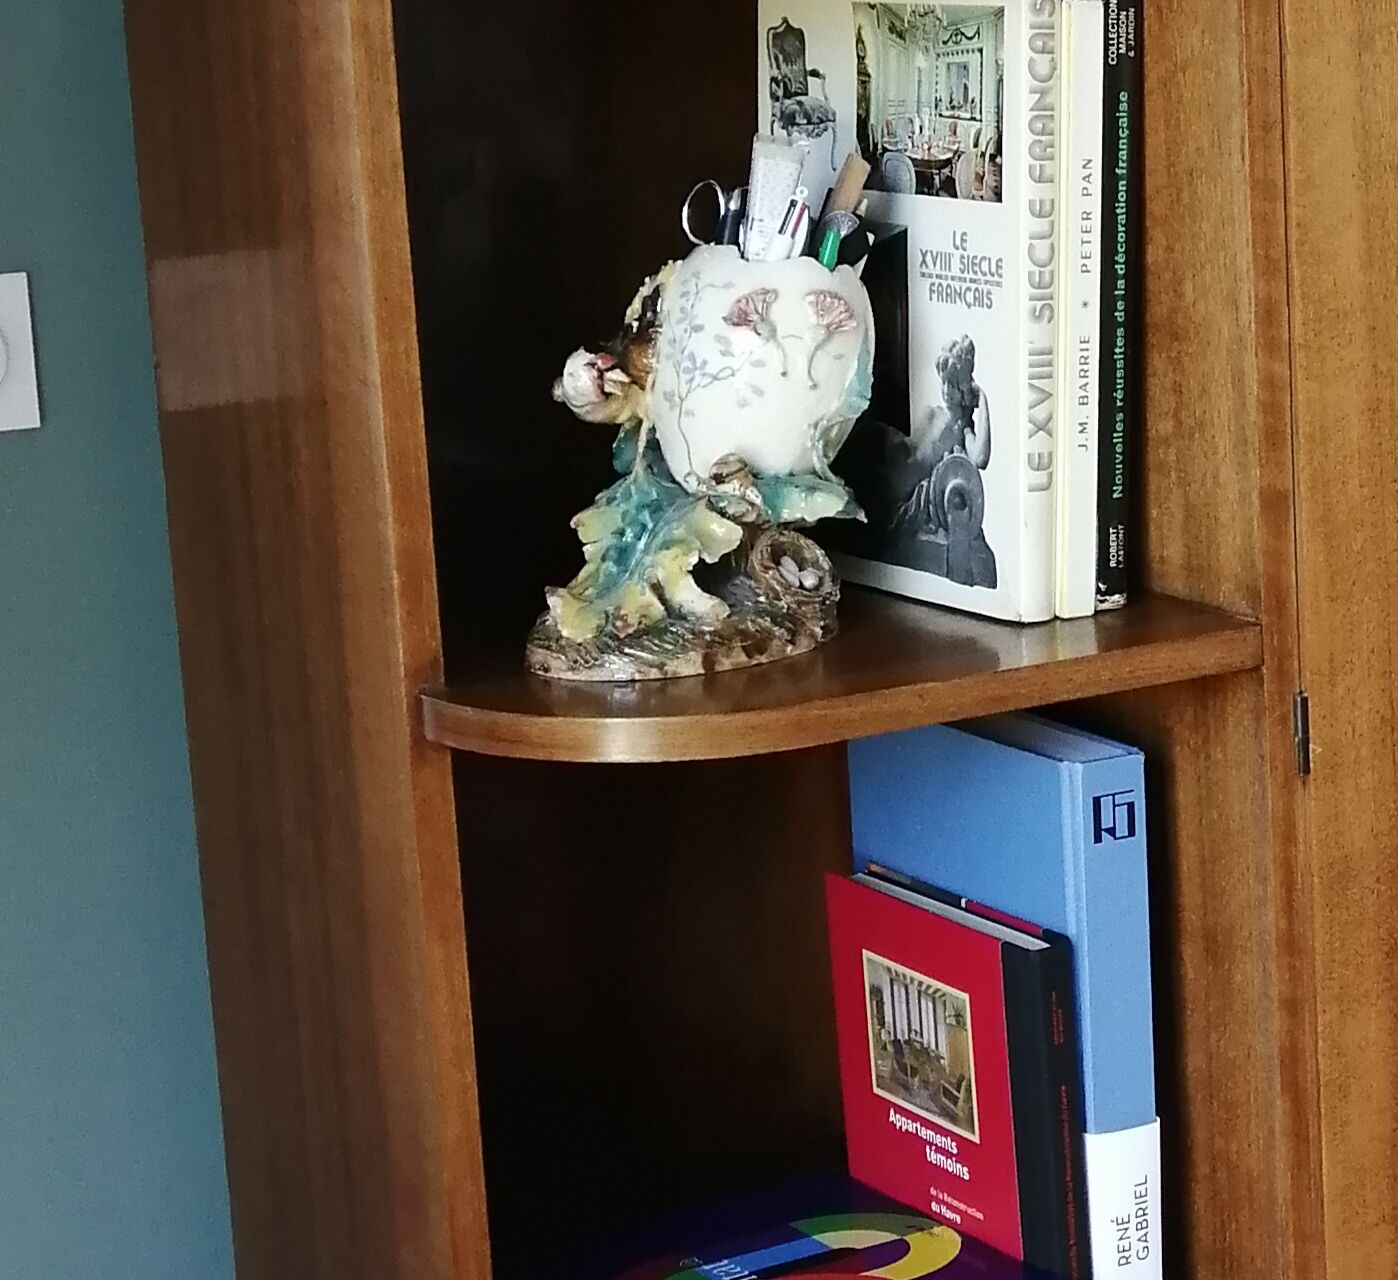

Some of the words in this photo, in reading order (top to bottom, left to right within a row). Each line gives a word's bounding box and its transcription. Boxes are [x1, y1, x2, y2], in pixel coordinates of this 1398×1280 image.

[1108, 0, 1118, 65] COLLECTION
[1119, 11, 1127, 54] MAISON
[1128, 8, 1136, 48] JARDIN
[1115, 91, 1129, 175] française
[1081, 158, 1093, 197] PAN
[953, 231, 967, 251] LE
[1081, 210, 1093, 274] PETER
[1114, 180, 1127, 275] décoration
[959, 254, 1003, 278] SIECLE
[1027, 198, 1055, 324] SIECLE
[929, 282, 993, 310] FRANÇAIS
[1114, 279, 1125, 295] la
[1113, 300, 1125, 322] de
[1078, 335, 1091, 406] BARRIE
[1113, 327, 1125, 407] réussites
[1077, 415, 1089, 452] J.M.
[1027, 451, 1053, 493] LE
[1112, 413, 1124, 499] Nouvelles
[1109, 527, 1117, 567] ROBERT
[889, 1107, 958, 1155] Appartements
[926, 1145, 970, 1181] témoins
[1134, 1174, 1150, 1261] GABRIEL
[1110, 1213, 1131, 1267] RENÉ
